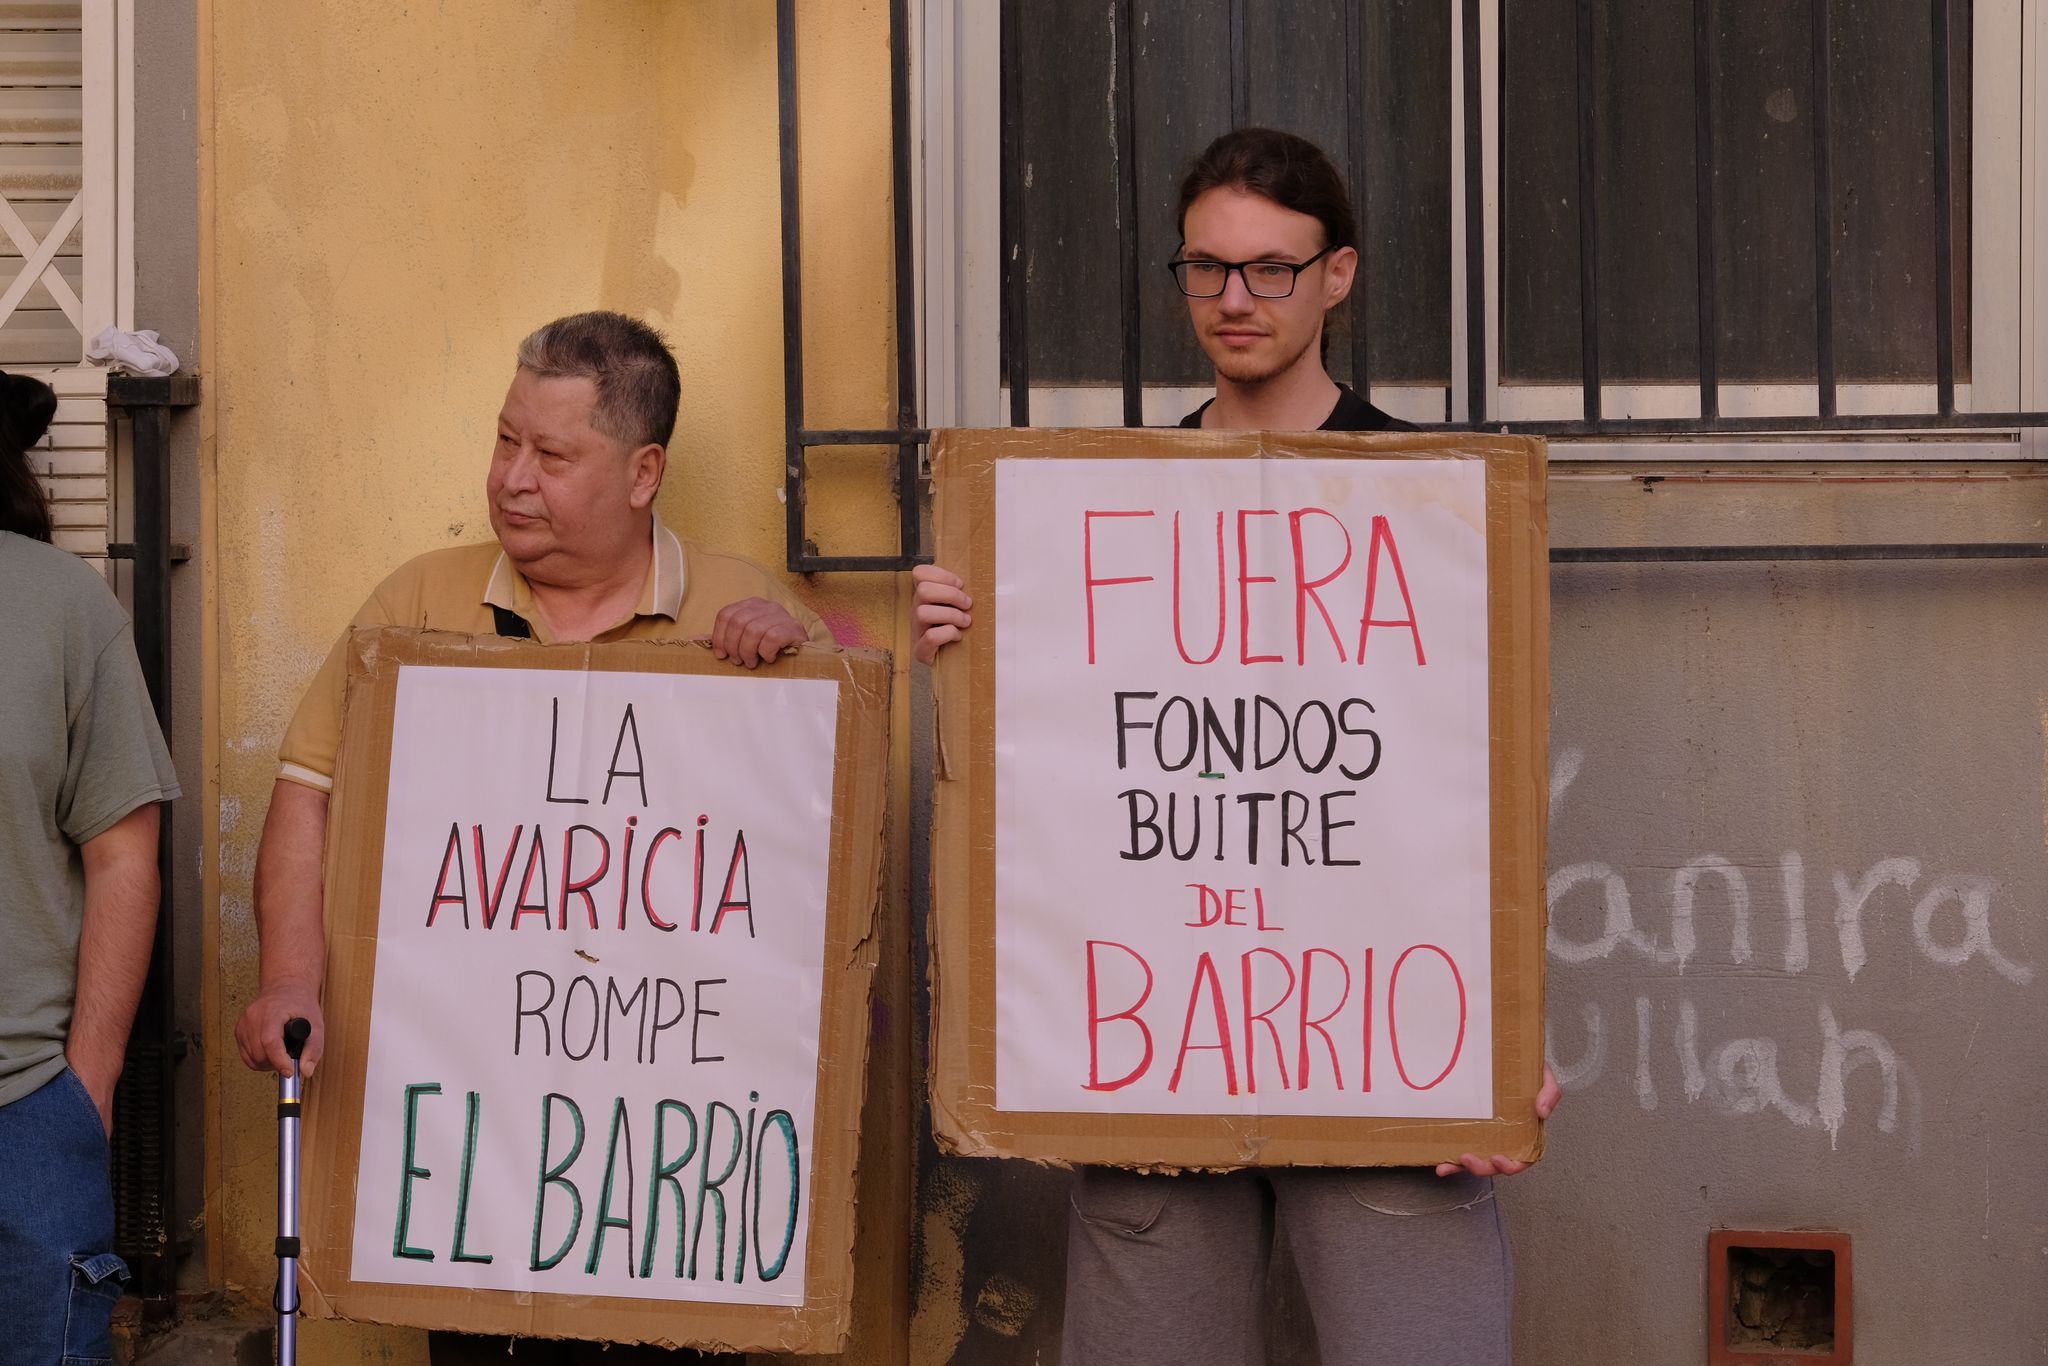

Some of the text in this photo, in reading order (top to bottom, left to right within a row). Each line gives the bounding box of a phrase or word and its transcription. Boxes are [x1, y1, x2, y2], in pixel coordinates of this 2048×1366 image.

[1084, 507, 1427, 667] FUERA
[545, 696, 649, 808] LA
[1114, 690, 1382, 781] FONDOS
[1117, 789, 1361, 867] BUITRE
[1547, 748, 2034, 985] anira
[1184, 883, 1285, 932] DEL
[514, 969, 728, 1065] ROMPE
[1080, 939, 1467, 1097] BARRIO
[392, 1081, 801, 1284] EL BARRIO
